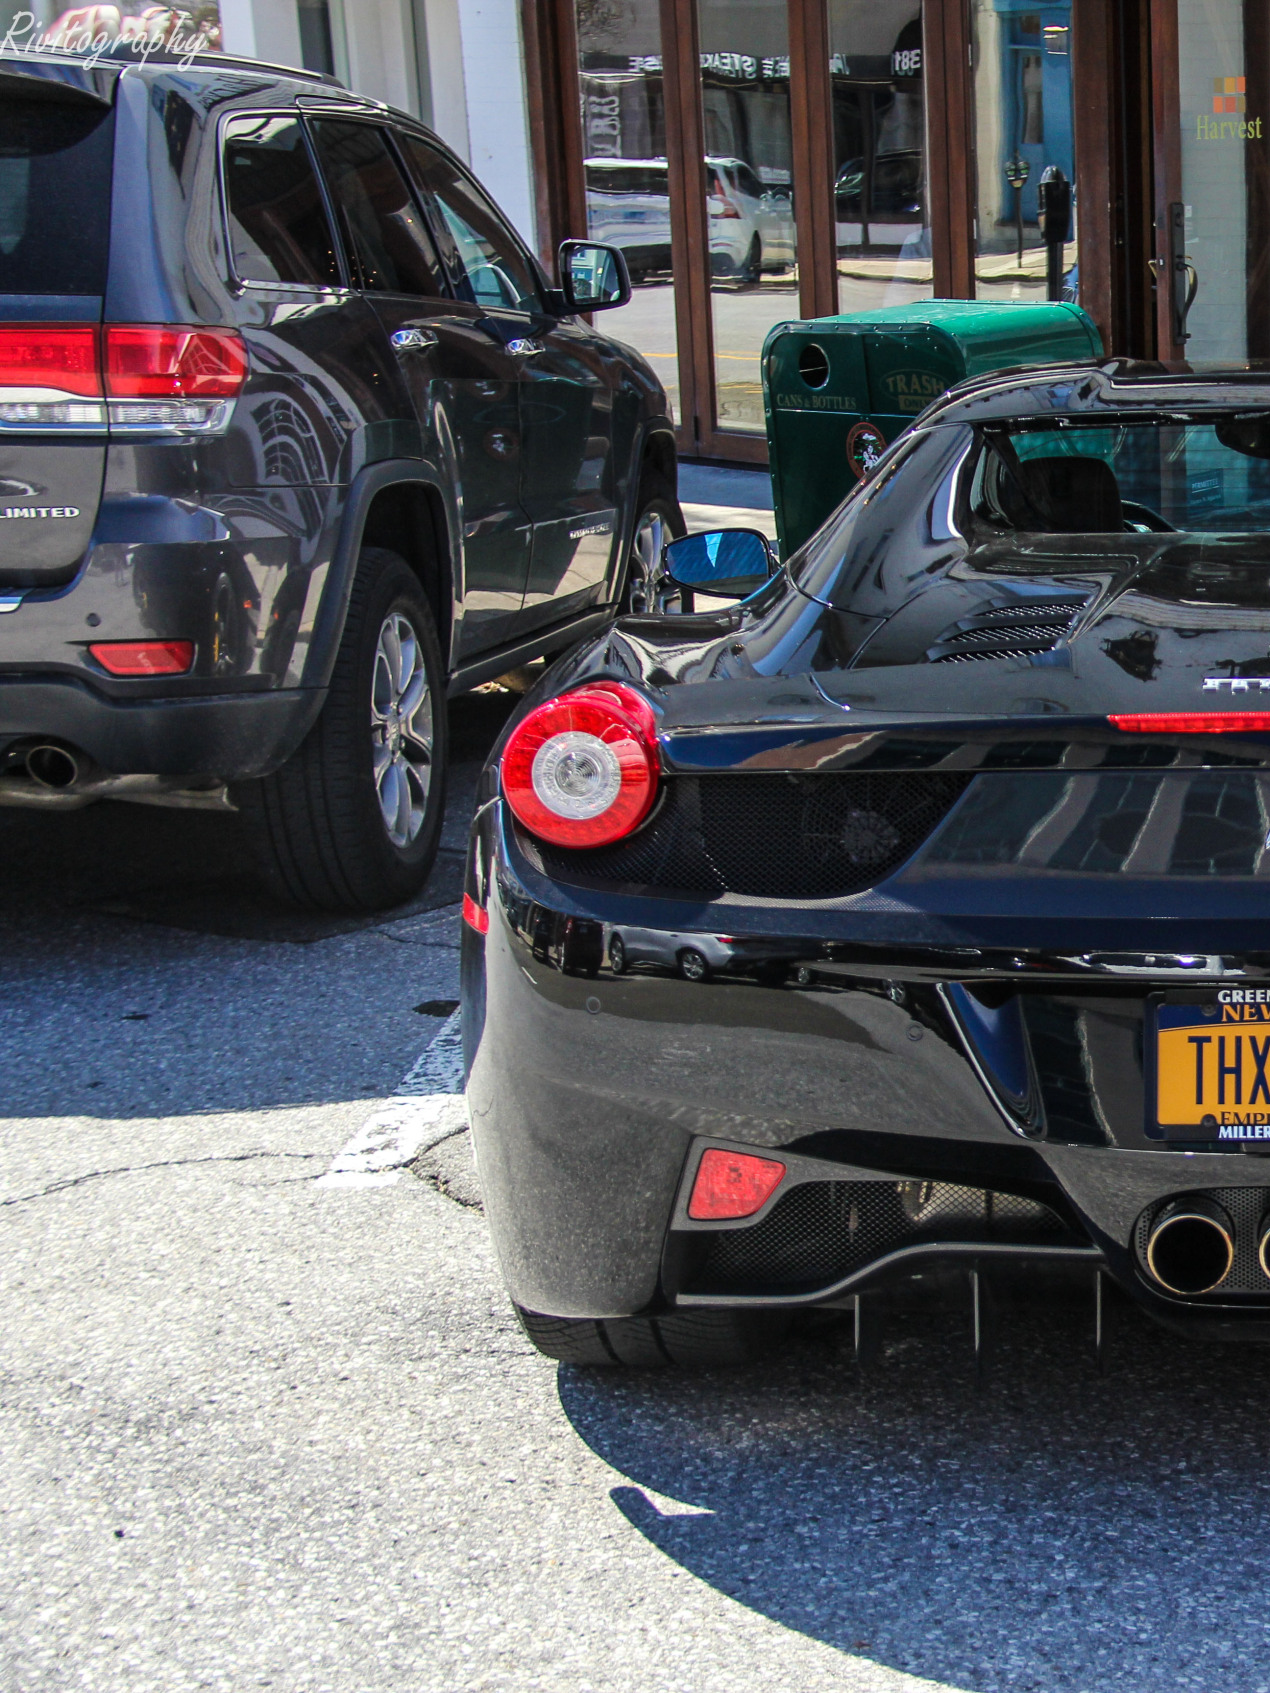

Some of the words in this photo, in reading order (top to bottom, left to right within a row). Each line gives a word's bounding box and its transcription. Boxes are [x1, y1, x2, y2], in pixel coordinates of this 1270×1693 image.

[1196, 114, 1263, 140] Harvest
[886, 374, 945, 394] TRASH
[776, 393, 803, 407] CANS
[812, 395, 857, 410] BOTTLES
